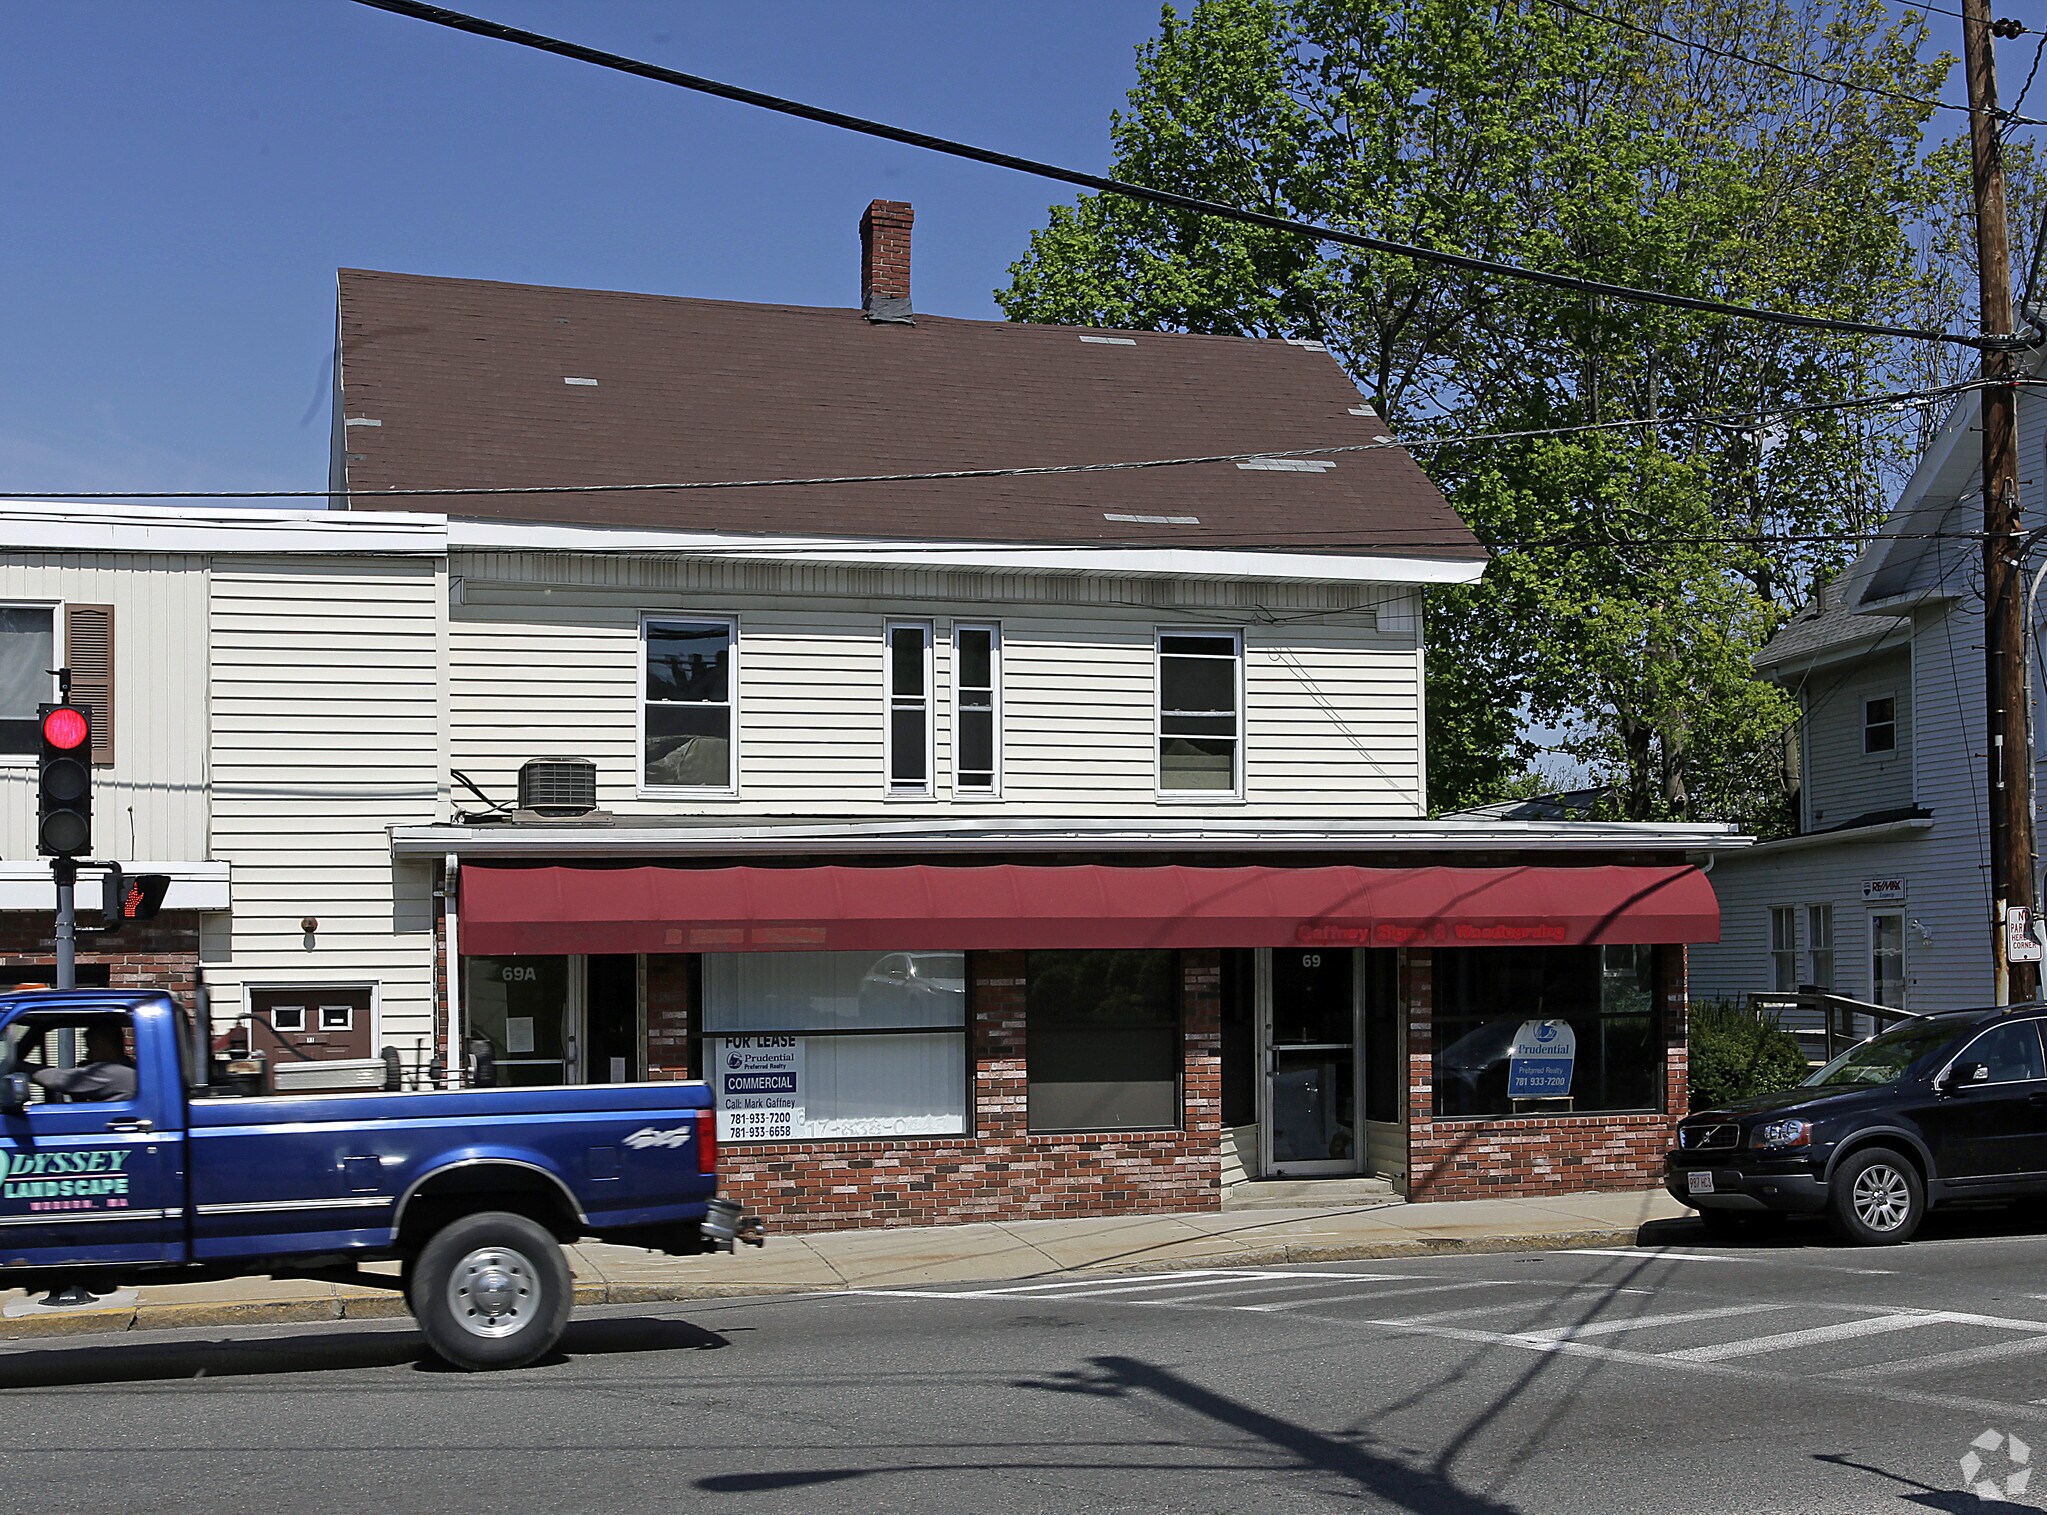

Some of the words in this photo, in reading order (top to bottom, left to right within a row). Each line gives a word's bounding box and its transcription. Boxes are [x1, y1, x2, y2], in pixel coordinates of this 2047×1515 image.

[1872, 880, 1902, 892] RE/MAX
[2018, 911, 2031, 921] NO
[2013, 941, 2037, 950] CORNER
[1303, 954, 1321, 968] 69
[502, 966, 537, 981] 69A
[725, 1036, 751, 1049] FOR
[757, 1036, 796, 1048] LEASE
[1519, 1045, 1570, 1055] Prudential
[744, 1053, 794, 1063] Prudential
[1519, 1066, 1544, 1074] Preferred
[1545, 1066, 1564, 1075] Realty
[728, 1076, 793, 1090] COMMERCIAL
[1515, 1077, 1528, 1086] 781
[1530, 1077, 1566, 1086] 933-7200
[725, 1099, 742, 1110] Call:
[744, 1099, 763, 1109] Mark
[766, 1097, 796, 1109] Gaffney
[730, 1112, 791, 1125] 781-933-7200
[730, 1126, 791, 1138] 781-933-6658
[4, 1178, 129, 1198] LANDSCAPE
